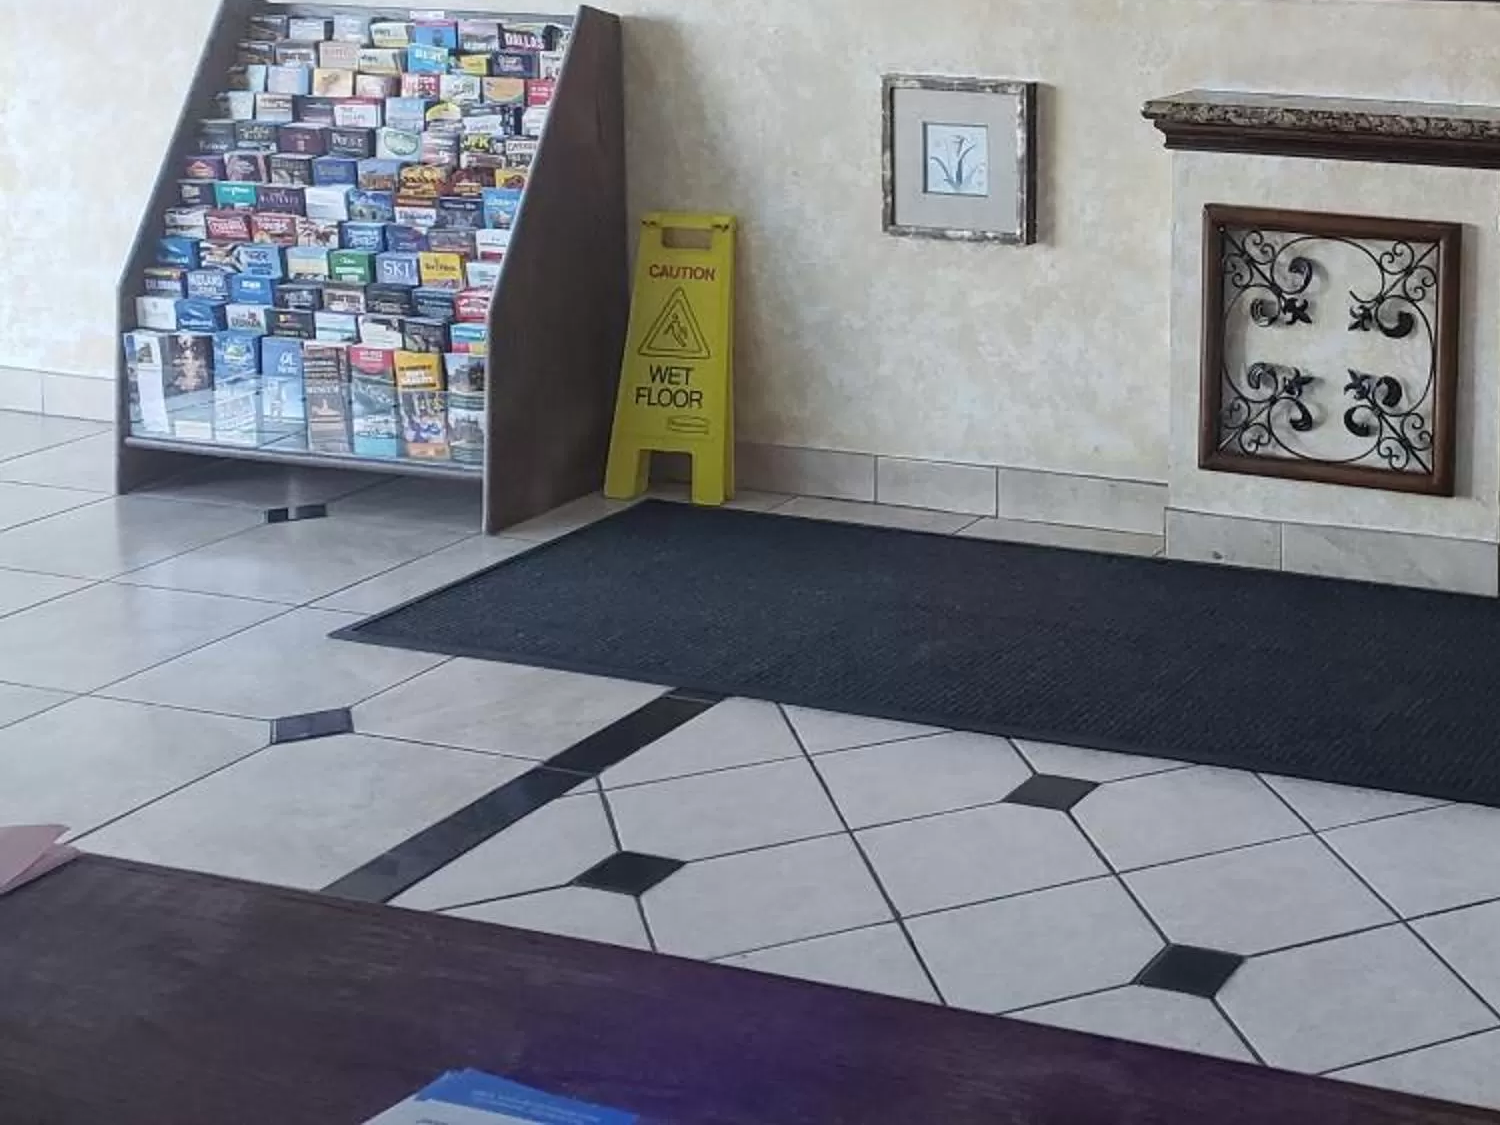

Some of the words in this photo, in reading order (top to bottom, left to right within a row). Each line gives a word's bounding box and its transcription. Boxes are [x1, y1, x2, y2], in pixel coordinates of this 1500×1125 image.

[505, 33, 545, 50] DALLAS
[383, 259, 411, 277] SKI
[649, 264, 715, 282] CAUTION
[649, 364, 694, 386] WET
[635, 386, 704, 410] FLOOR
